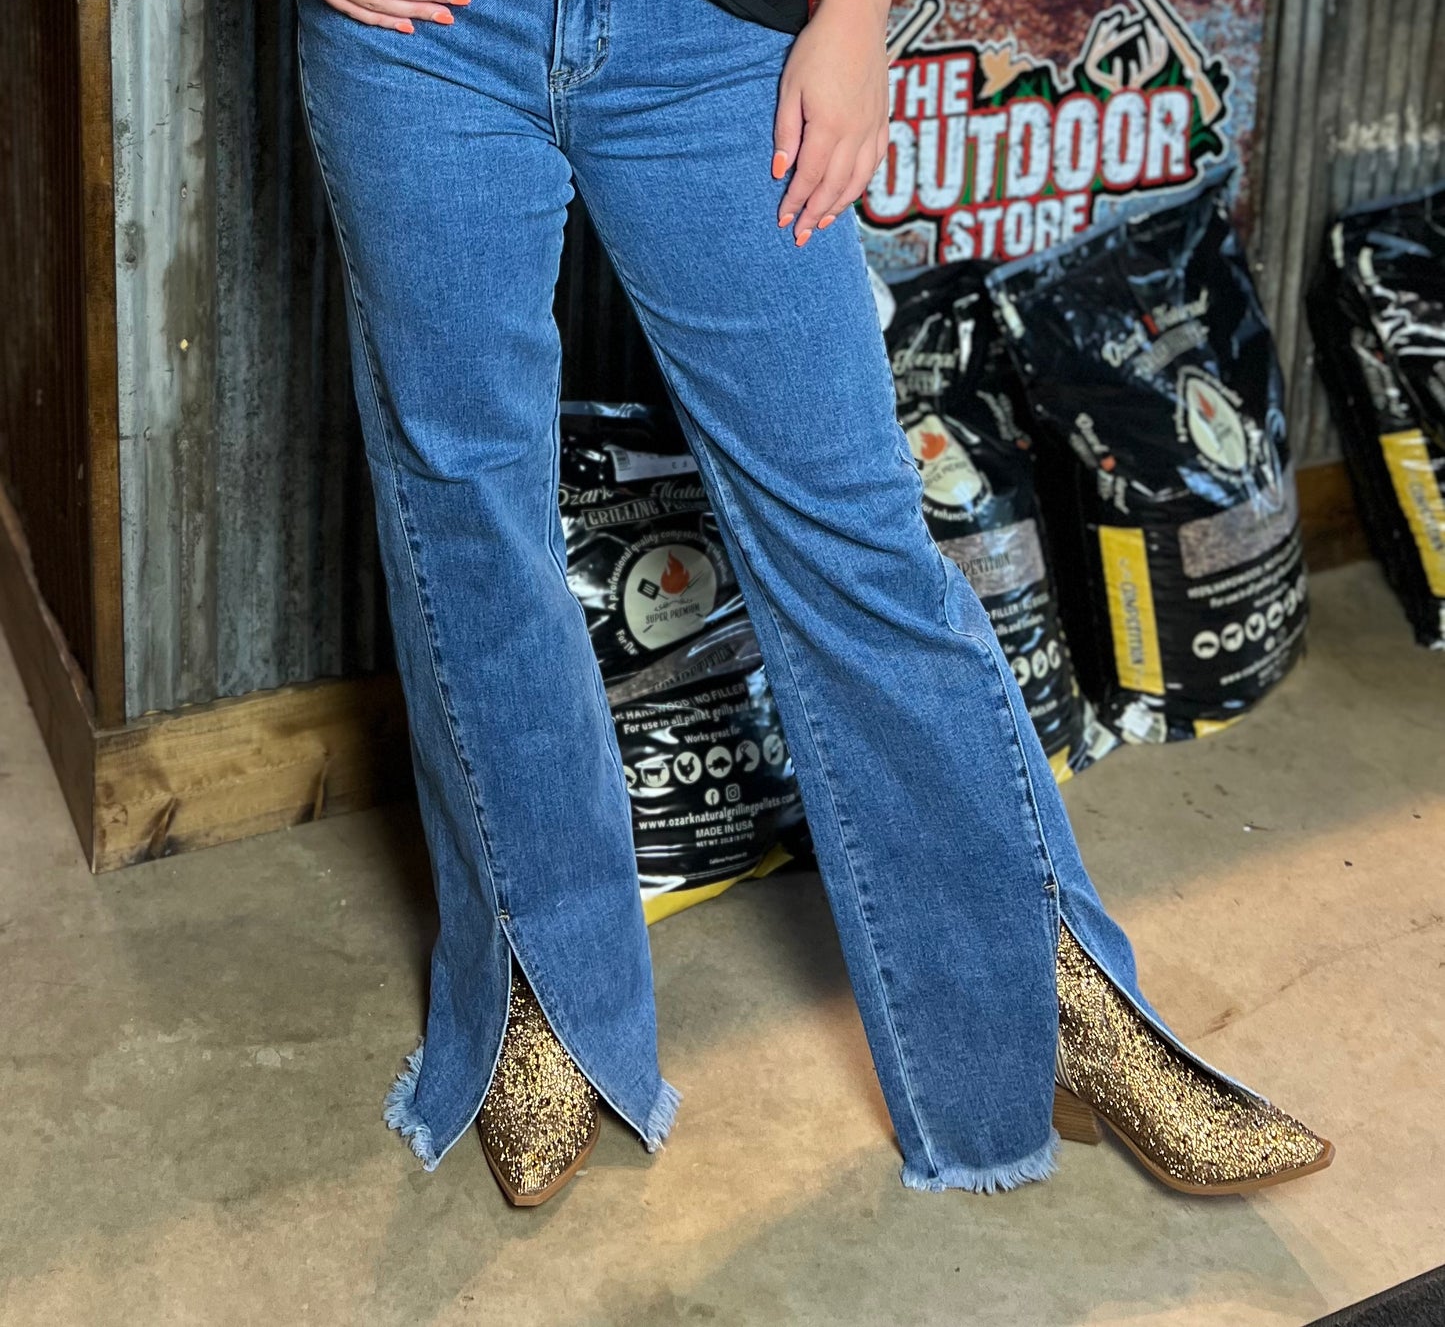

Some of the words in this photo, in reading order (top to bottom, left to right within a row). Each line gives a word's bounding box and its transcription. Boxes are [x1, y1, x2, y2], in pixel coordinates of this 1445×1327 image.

[889, 58, 971, 118] THE
[866, 90, 1188, 217] OUTDOOR
[944, 193, 1088, 262] STORE
[652, 481, 706, 500] Natu
[587, 498, 660, 526] GRILLING
[607, 547, 633, 602] professional
[630, 534, 660, 553] quality
[957, 552, 1011, 577] PETITION
[645, 611, 670, 625] SUPER
[670, 602, 701, 619] PREMIUM
[1121, 581, 1145, 665] COMPETITION
[694, 693, 711, 705] NO
[712, 683, 746, 700] FILLER
[623, 723, 640, 735] For
[642, 721, 659, 731] use
[660, 719, 670, 727] in
[671, 715, 683, 725] all
[711, 705, 735, 722] grills
[684, 733, 710, 745] Works
[710, 728, 731, 743] great
[638, 793, 796, 830] www.ozarknaturalgrillingpellets.com
[695, 826, 723, 839] MADE
[724, 824, 734, 834] IN
[735, 819, 754, 832] USA
